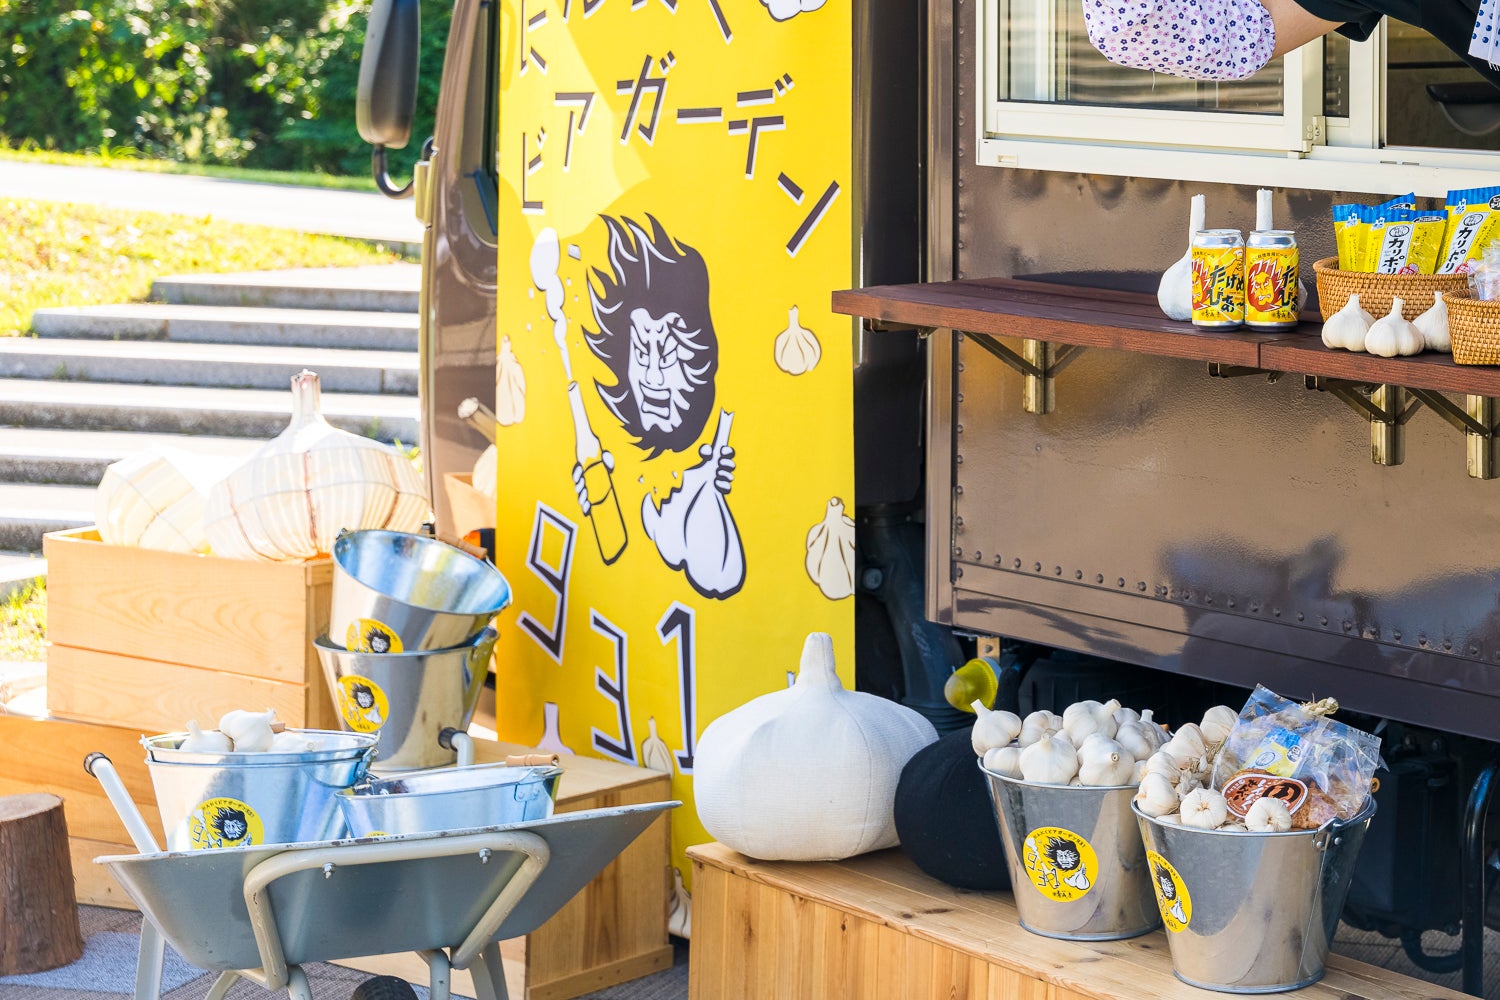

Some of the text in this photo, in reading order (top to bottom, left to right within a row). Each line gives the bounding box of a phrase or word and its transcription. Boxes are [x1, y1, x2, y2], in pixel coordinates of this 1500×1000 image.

[520, 51, 841, 257] ビアガーデン
